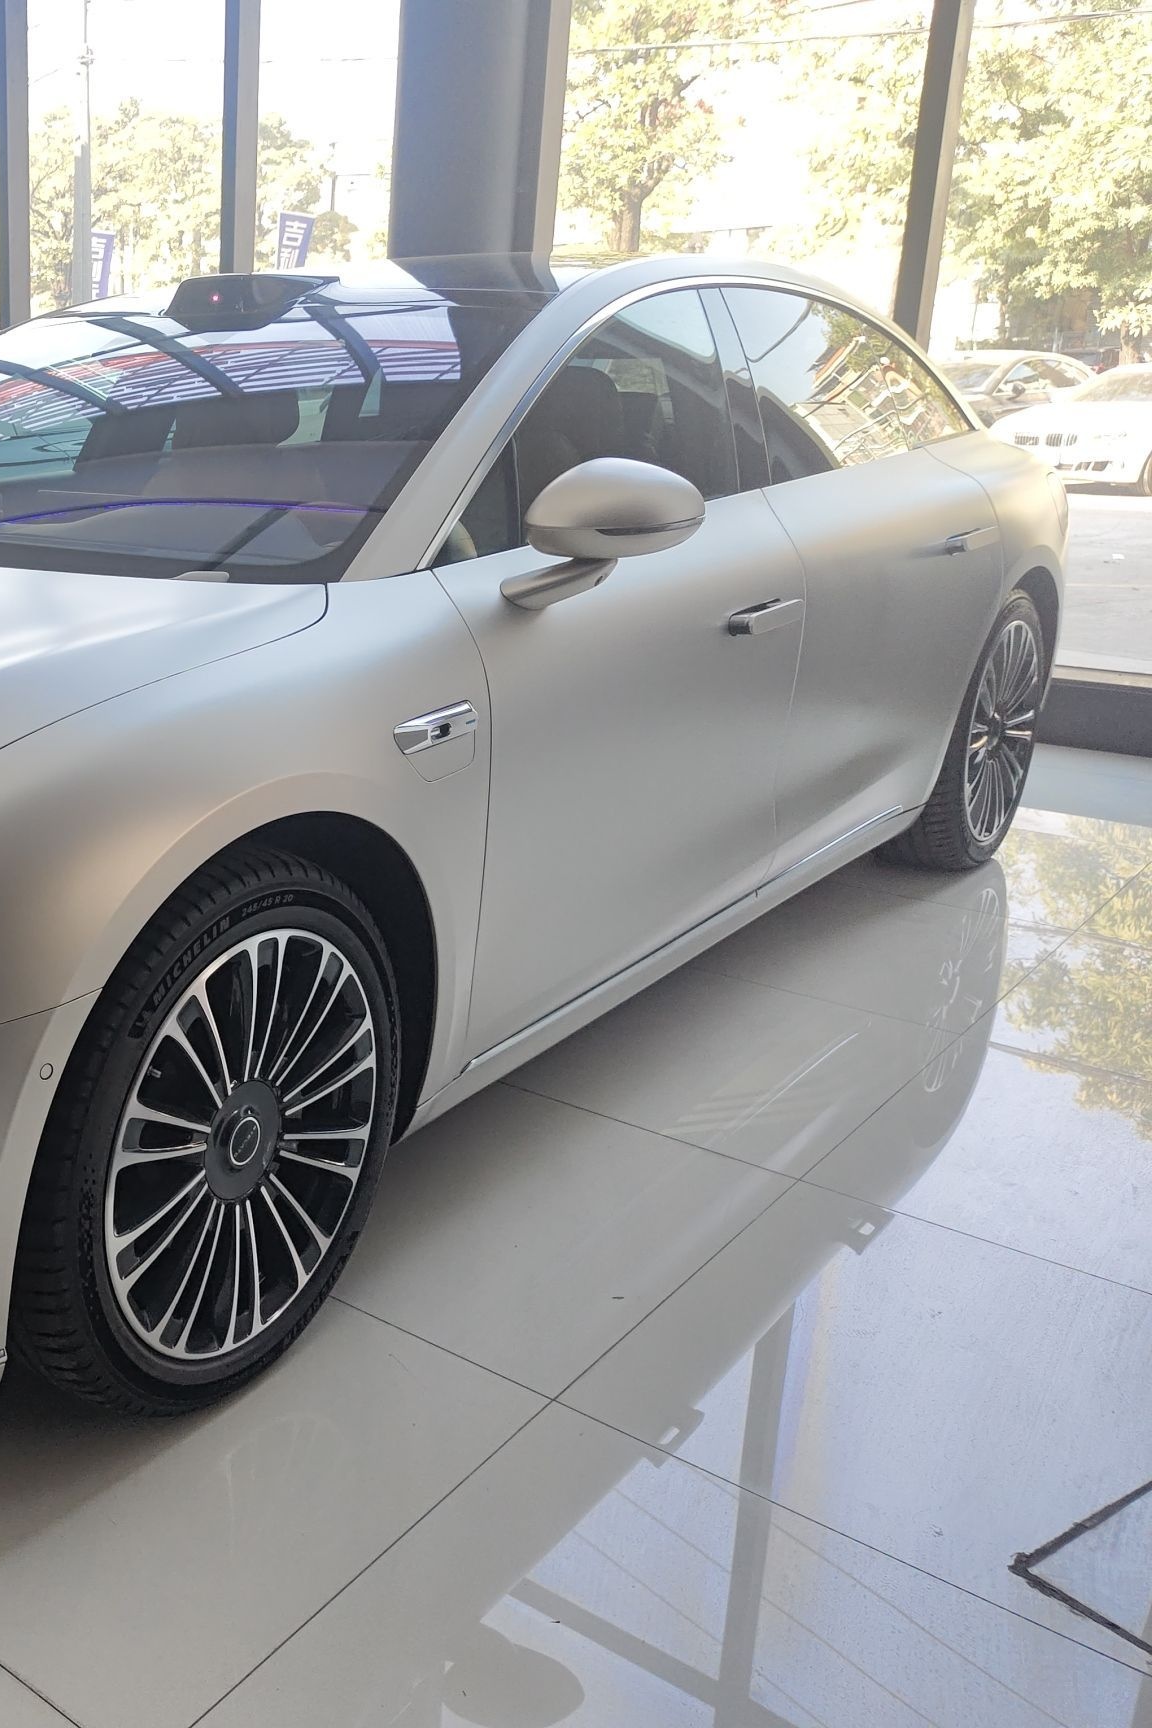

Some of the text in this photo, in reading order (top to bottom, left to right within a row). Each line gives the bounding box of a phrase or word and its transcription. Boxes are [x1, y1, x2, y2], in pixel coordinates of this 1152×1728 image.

[241, 894, 294, 917] 245/45 R 20
[153, 916, 231, 1006] MICHELIN
